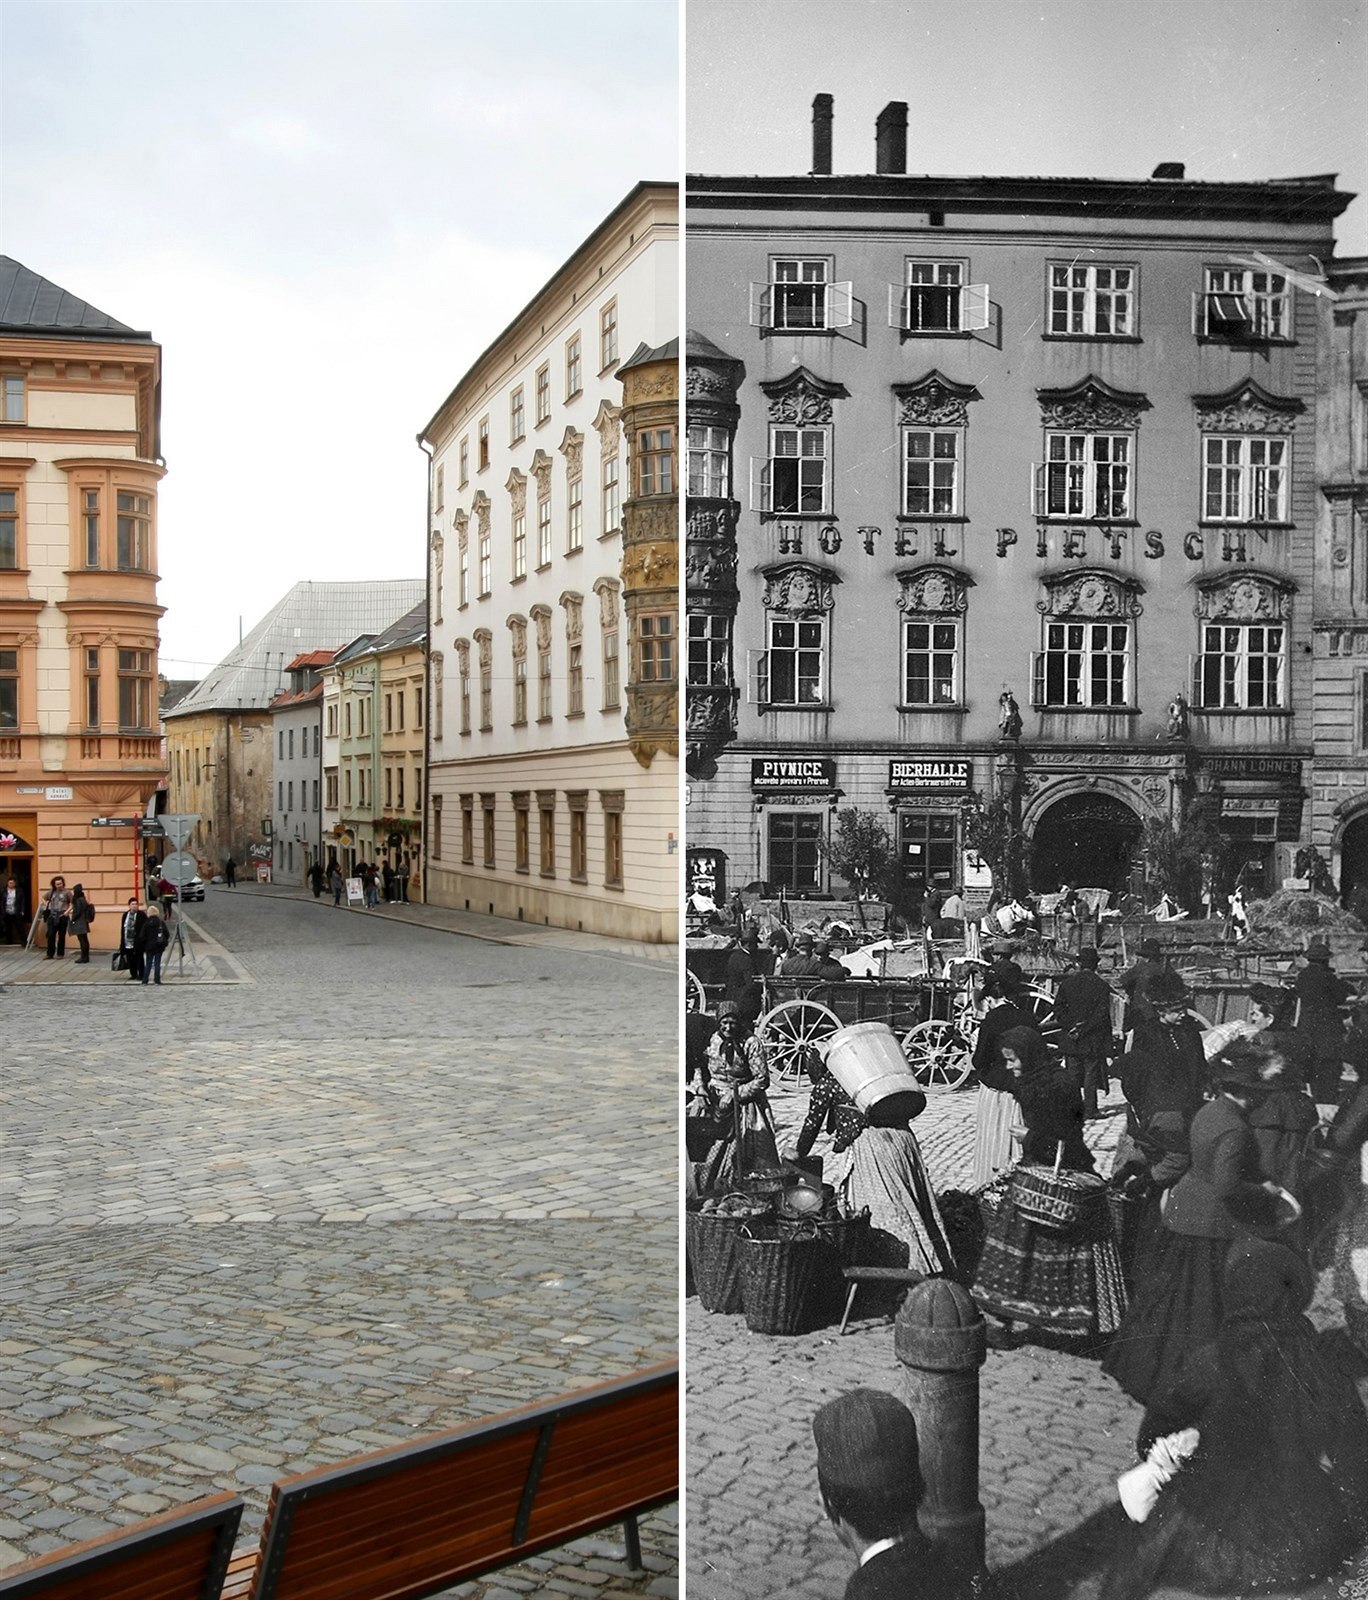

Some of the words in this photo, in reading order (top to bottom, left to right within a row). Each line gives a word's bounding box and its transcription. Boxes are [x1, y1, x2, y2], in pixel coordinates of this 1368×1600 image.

[762, 762, 823, 776] PIVNICE
[892, 763, 968, 777] BIERHALLE
[1250, 760, 1299, 773] LOHNER
